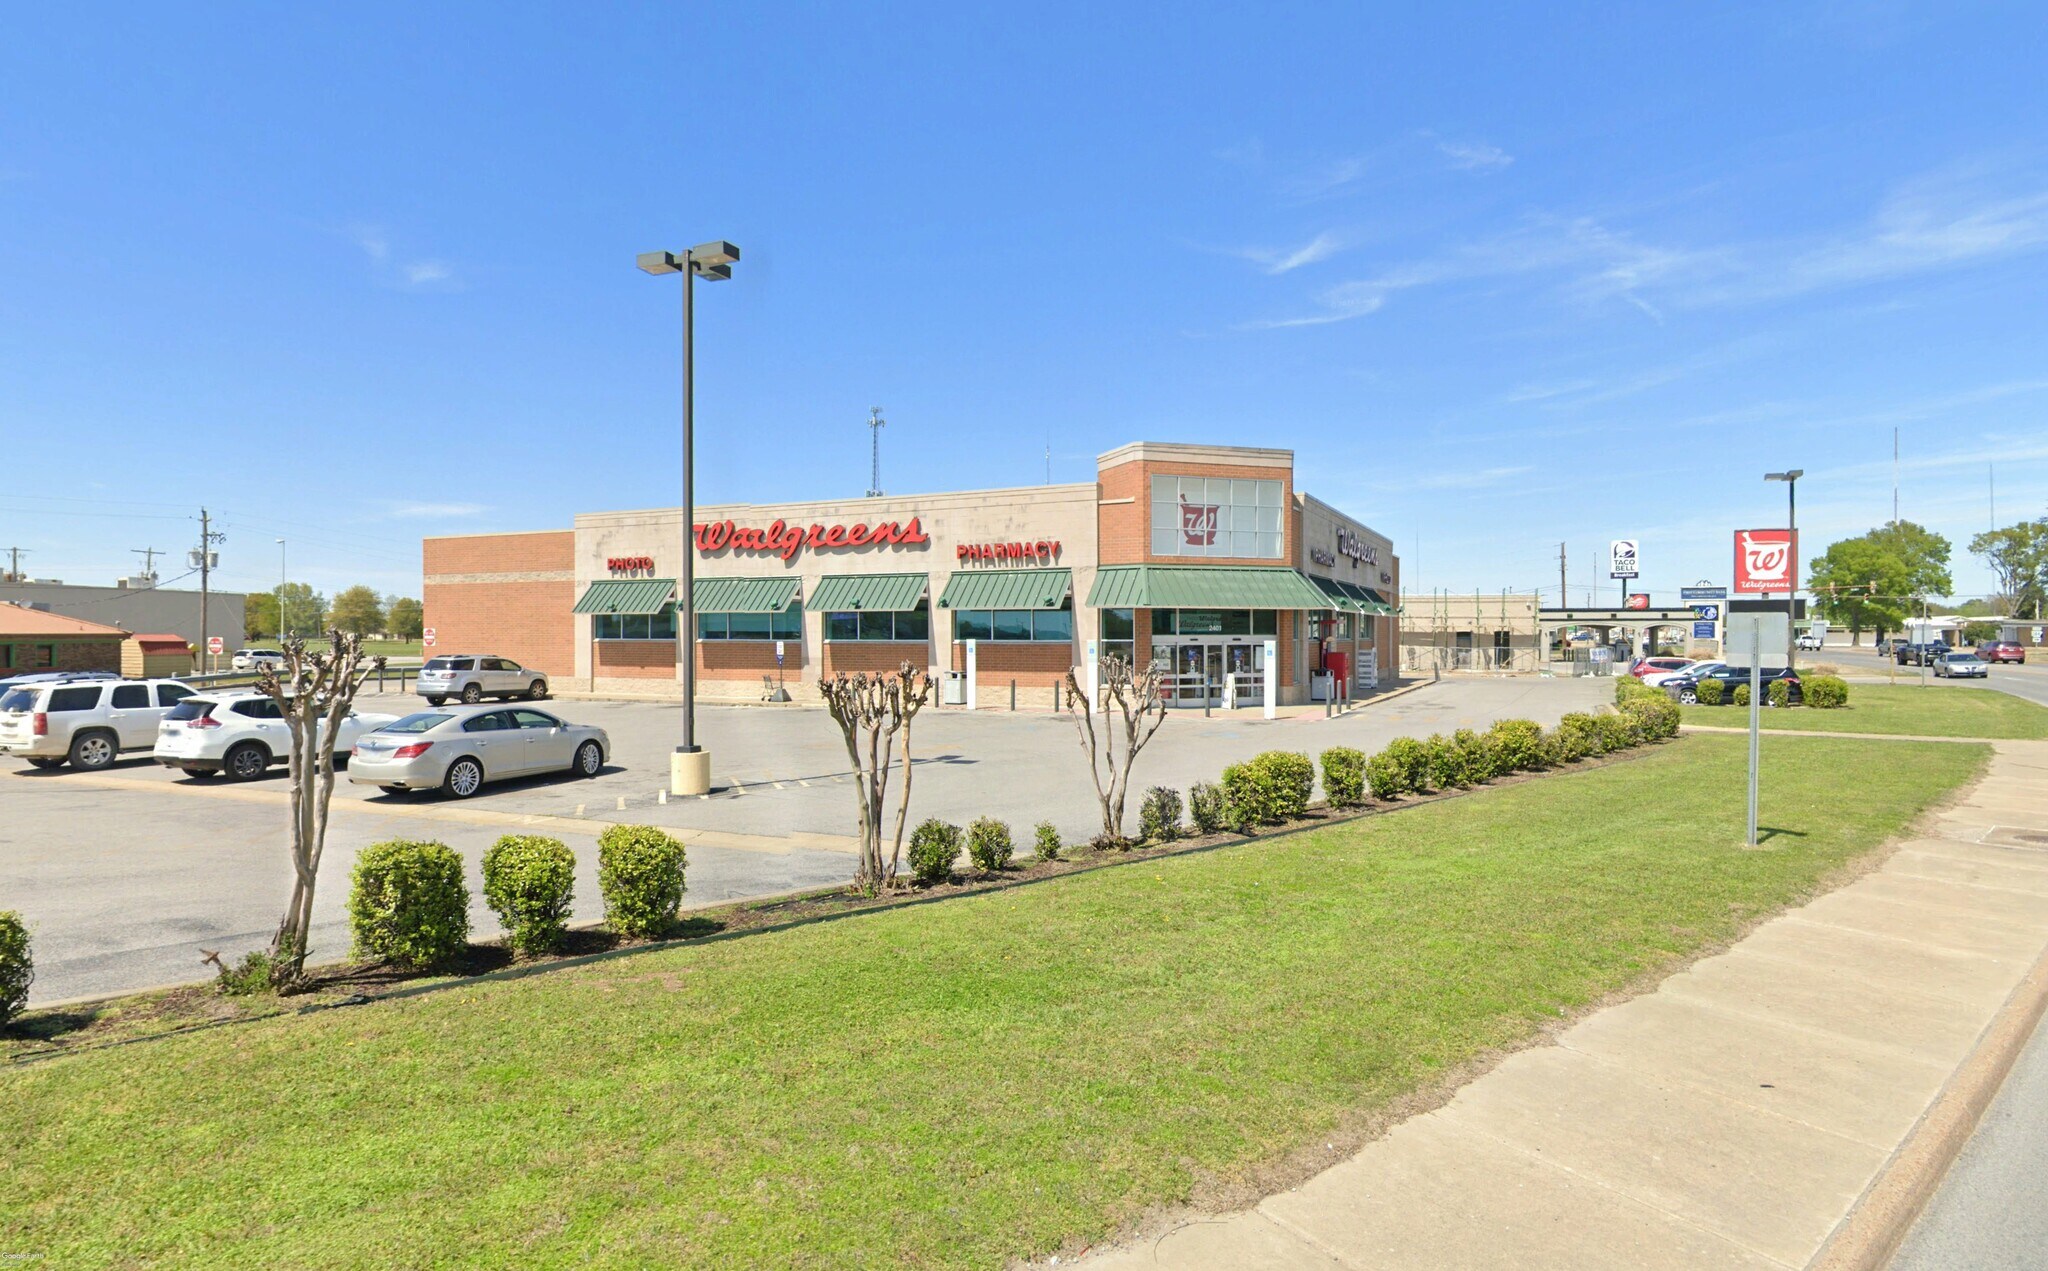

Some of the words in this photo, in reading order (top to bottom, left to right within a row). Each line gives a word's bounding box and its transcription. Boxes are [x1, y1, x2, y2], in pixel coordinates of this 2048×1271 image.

[692, 516, 929, 561] Walgreens
[956, 540, 1060, 560] PHARMACY
[1748, 548, 1785, 571] W
[607, 556, 653, 571] PHOTO
[1741, 581, 1791, 591] Walgreens
